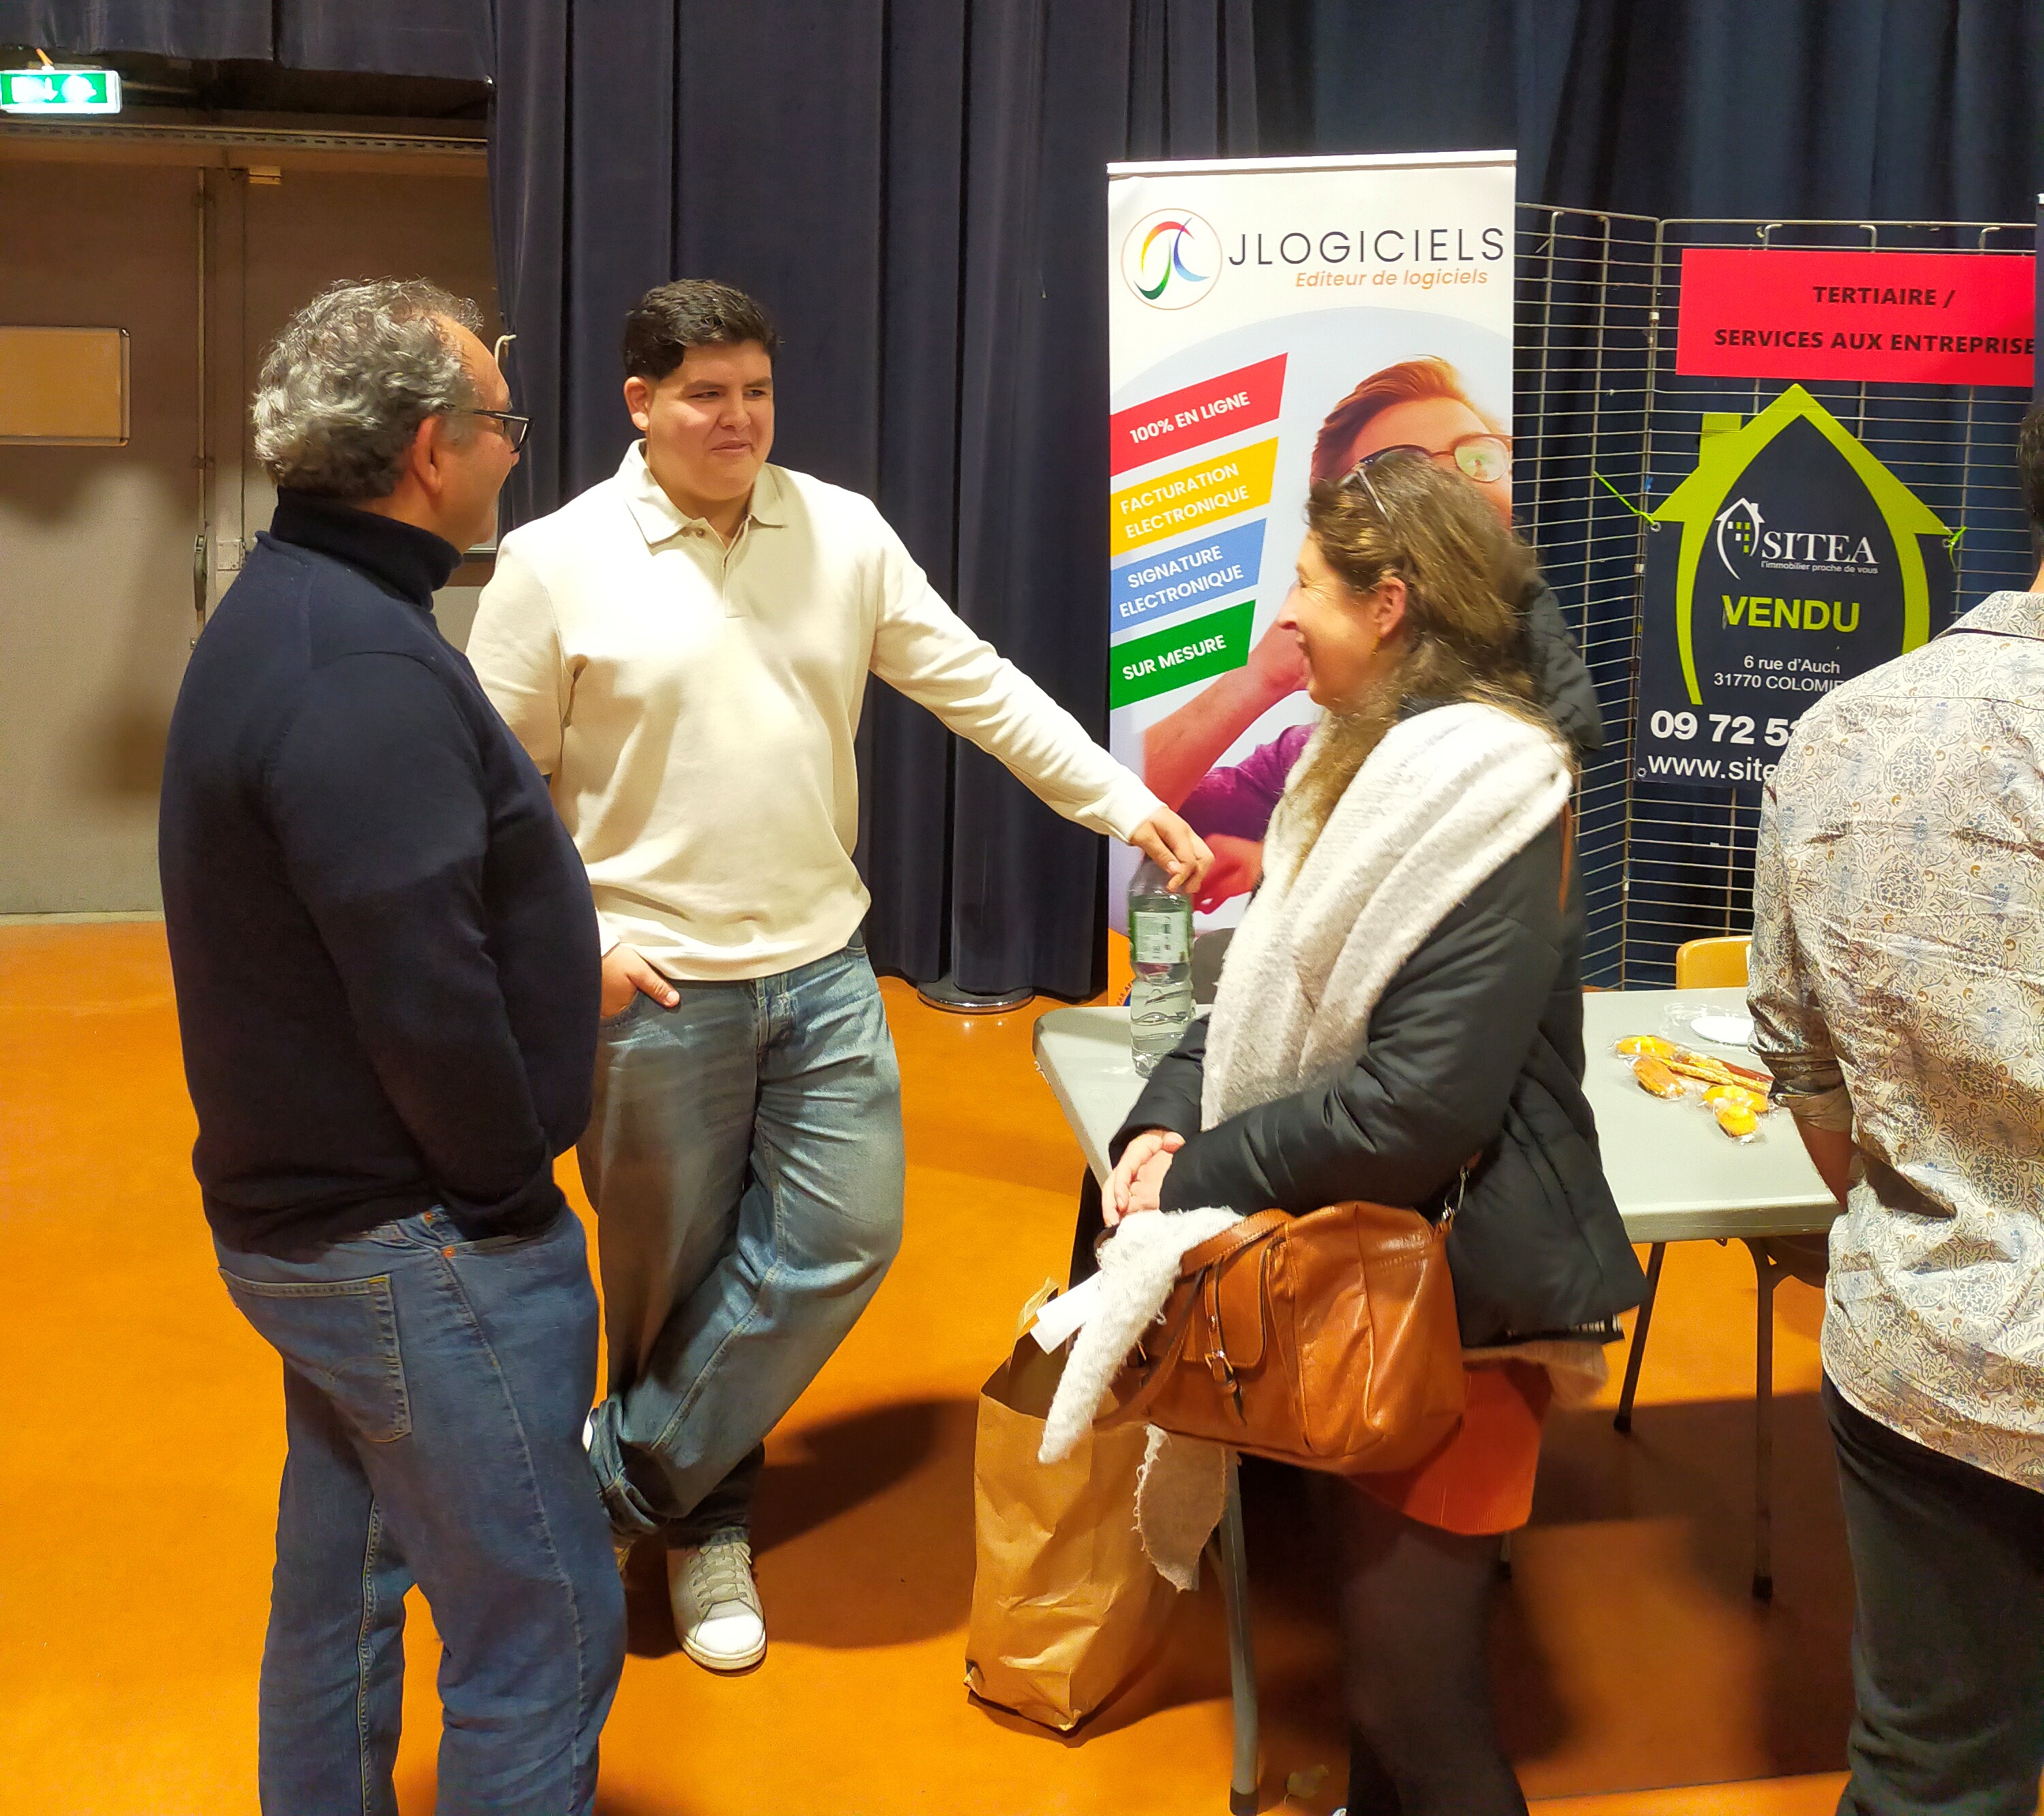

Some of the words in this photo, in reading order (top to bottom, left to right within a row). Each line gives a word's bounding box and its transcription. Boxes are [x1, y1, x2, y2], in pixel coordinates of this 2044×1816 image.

[1228, 228, 1504, 266] JLOGICIELS
[1295, 271, 1367, 287] Editeur
[1372, 270, 1397, 286] de
[1404, 268, 1488, 290] logiciels
[1812, 286, 1936, 306] TERTIAIRE
[1942, 290, 1955, 309] /
[1714, 329, 1823, 348] SERVICES
[1831, 333, 1882, 350] AUX
[1129, 418, 1174, 444] 100%
[1177, 408, 1200, 428] EN
[1200, 391, 1251, 420] LIGNE
[1120, 463, 1239, 515] FACTURATION
[1125, 485, 1250, 539] ELECTRONIQUE
[1127, 545, 1223, 588] SIGNATURE
[1761, 531, 1880, 565] SITEA
[1812, 564, 1842, 572] proche
[1844, 565, 1856, 573] de
[1119, 564, 1244, 618] ELECTRONIQUE
[1721, 595, 1860, 632] VENDU
[1122, 659, 1157, 680] SUR
[1158, 635, 1227, 668] MESURE
[1744, 656, 1754, 668] 6
[1759, 659, 1784, 671] rue
[1788, 658, 1840, 674] d'Auch
[1714, 673, 1762, 688] 31770
[1650, 710, 1698, 740] 09
[1709, 713, 1755, 745] 72
[1764, 718, 1800, 747] 5
